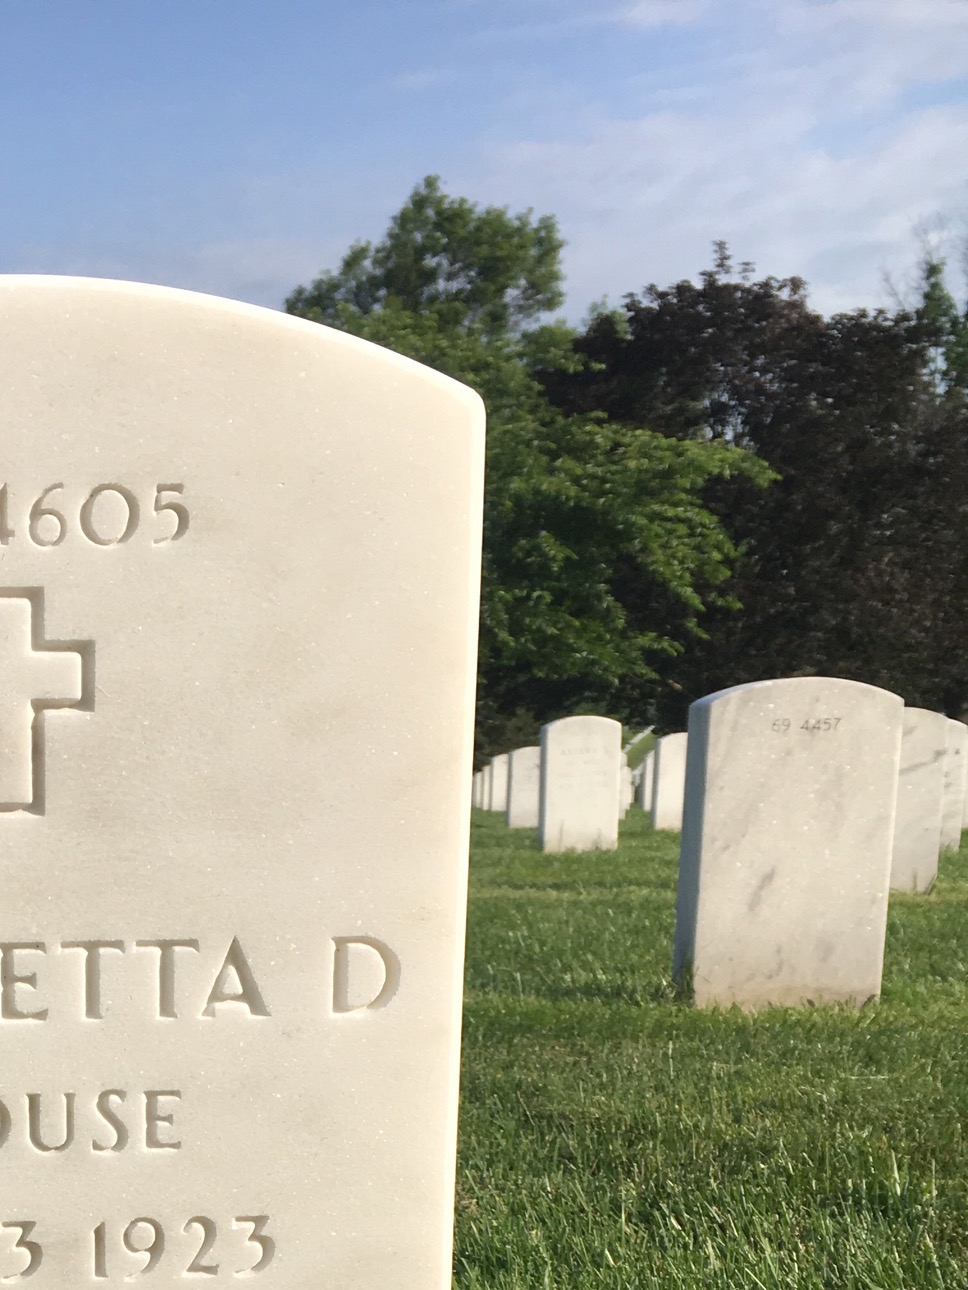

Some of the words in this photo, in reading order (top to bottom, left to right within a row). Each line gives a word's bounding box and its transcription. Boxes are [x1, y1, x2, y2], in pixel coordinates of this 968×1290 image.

[772, 718, 791, 733] 69
[799, 717, 841, 733] 4457
[331, 935, 402, 1017] D
[92, 1215, 277, 1280] 1923
